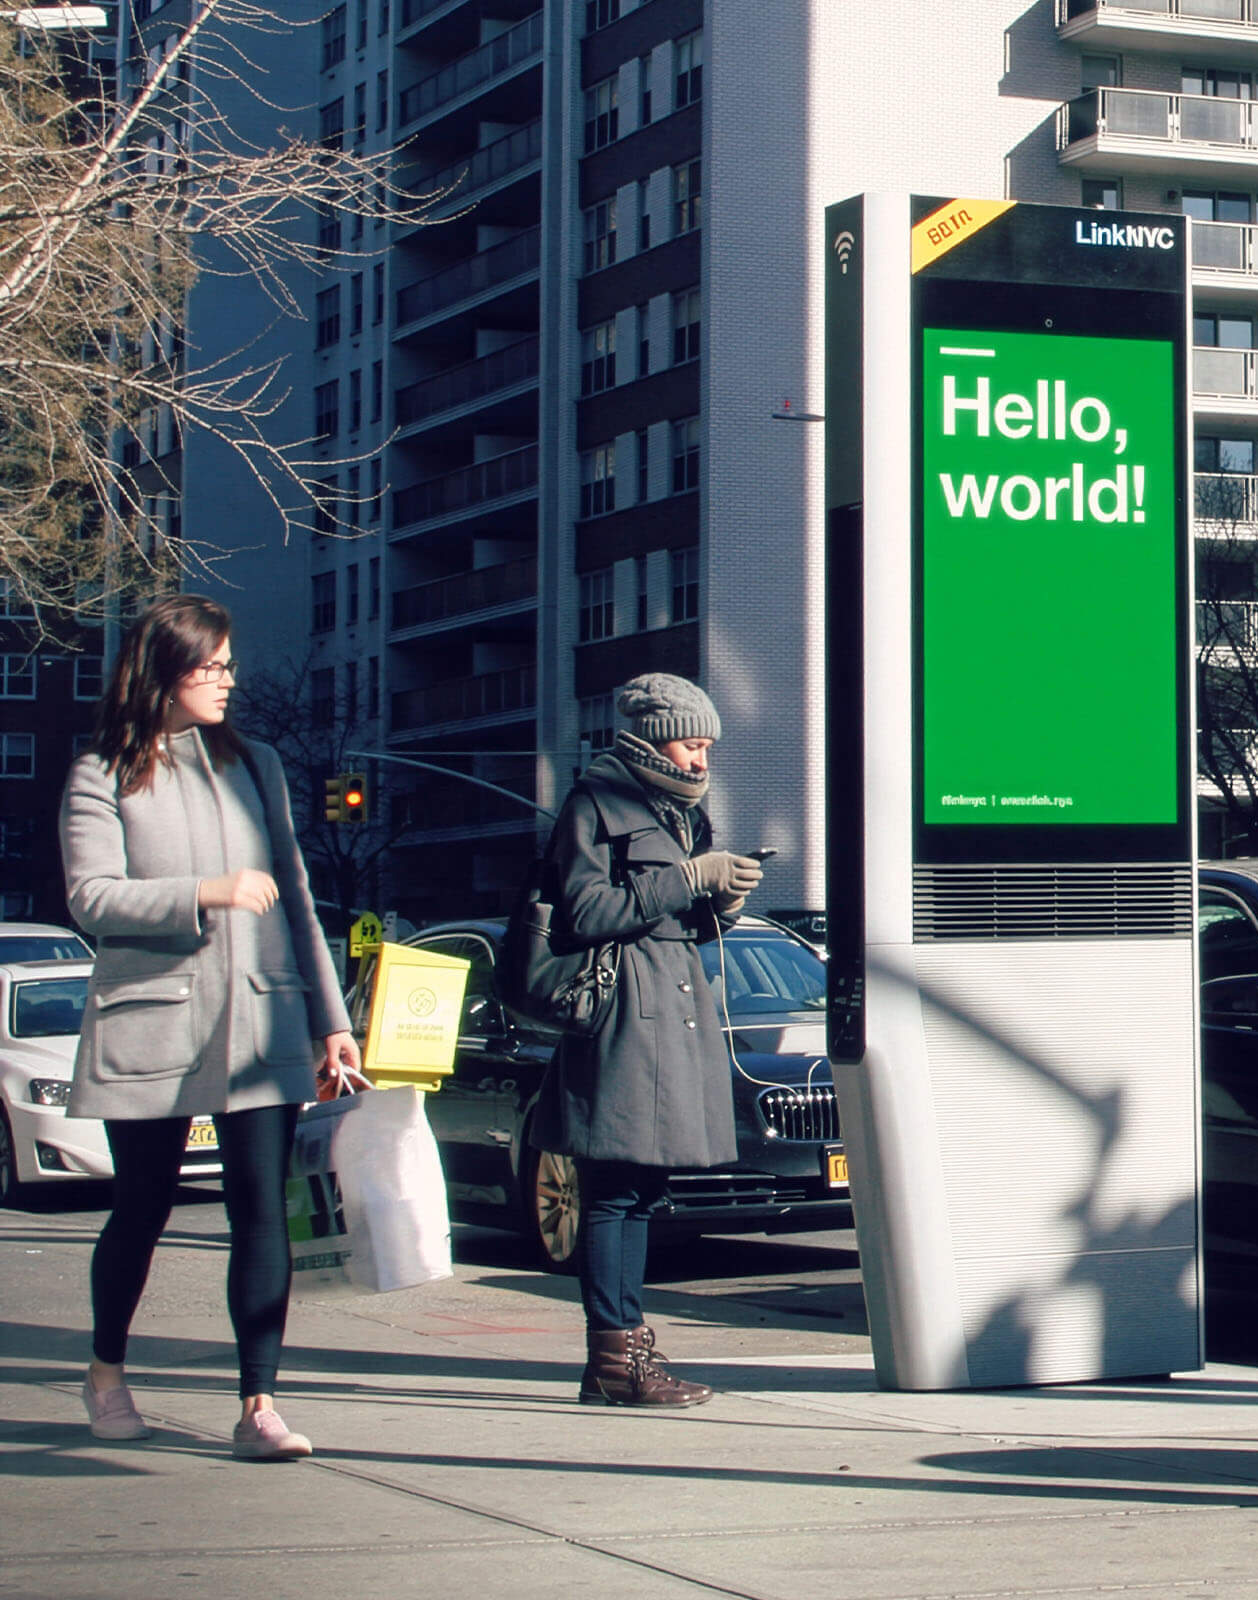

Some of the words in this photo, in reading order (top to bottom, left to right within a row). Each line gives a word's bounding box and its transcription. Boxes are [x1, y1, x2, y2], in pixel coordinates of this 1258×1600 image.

[1075, 220, 1175, 250] LinkNYC
[942, 374, 1128, 455] Hello,
[938, 462, 1146, 523] world!
